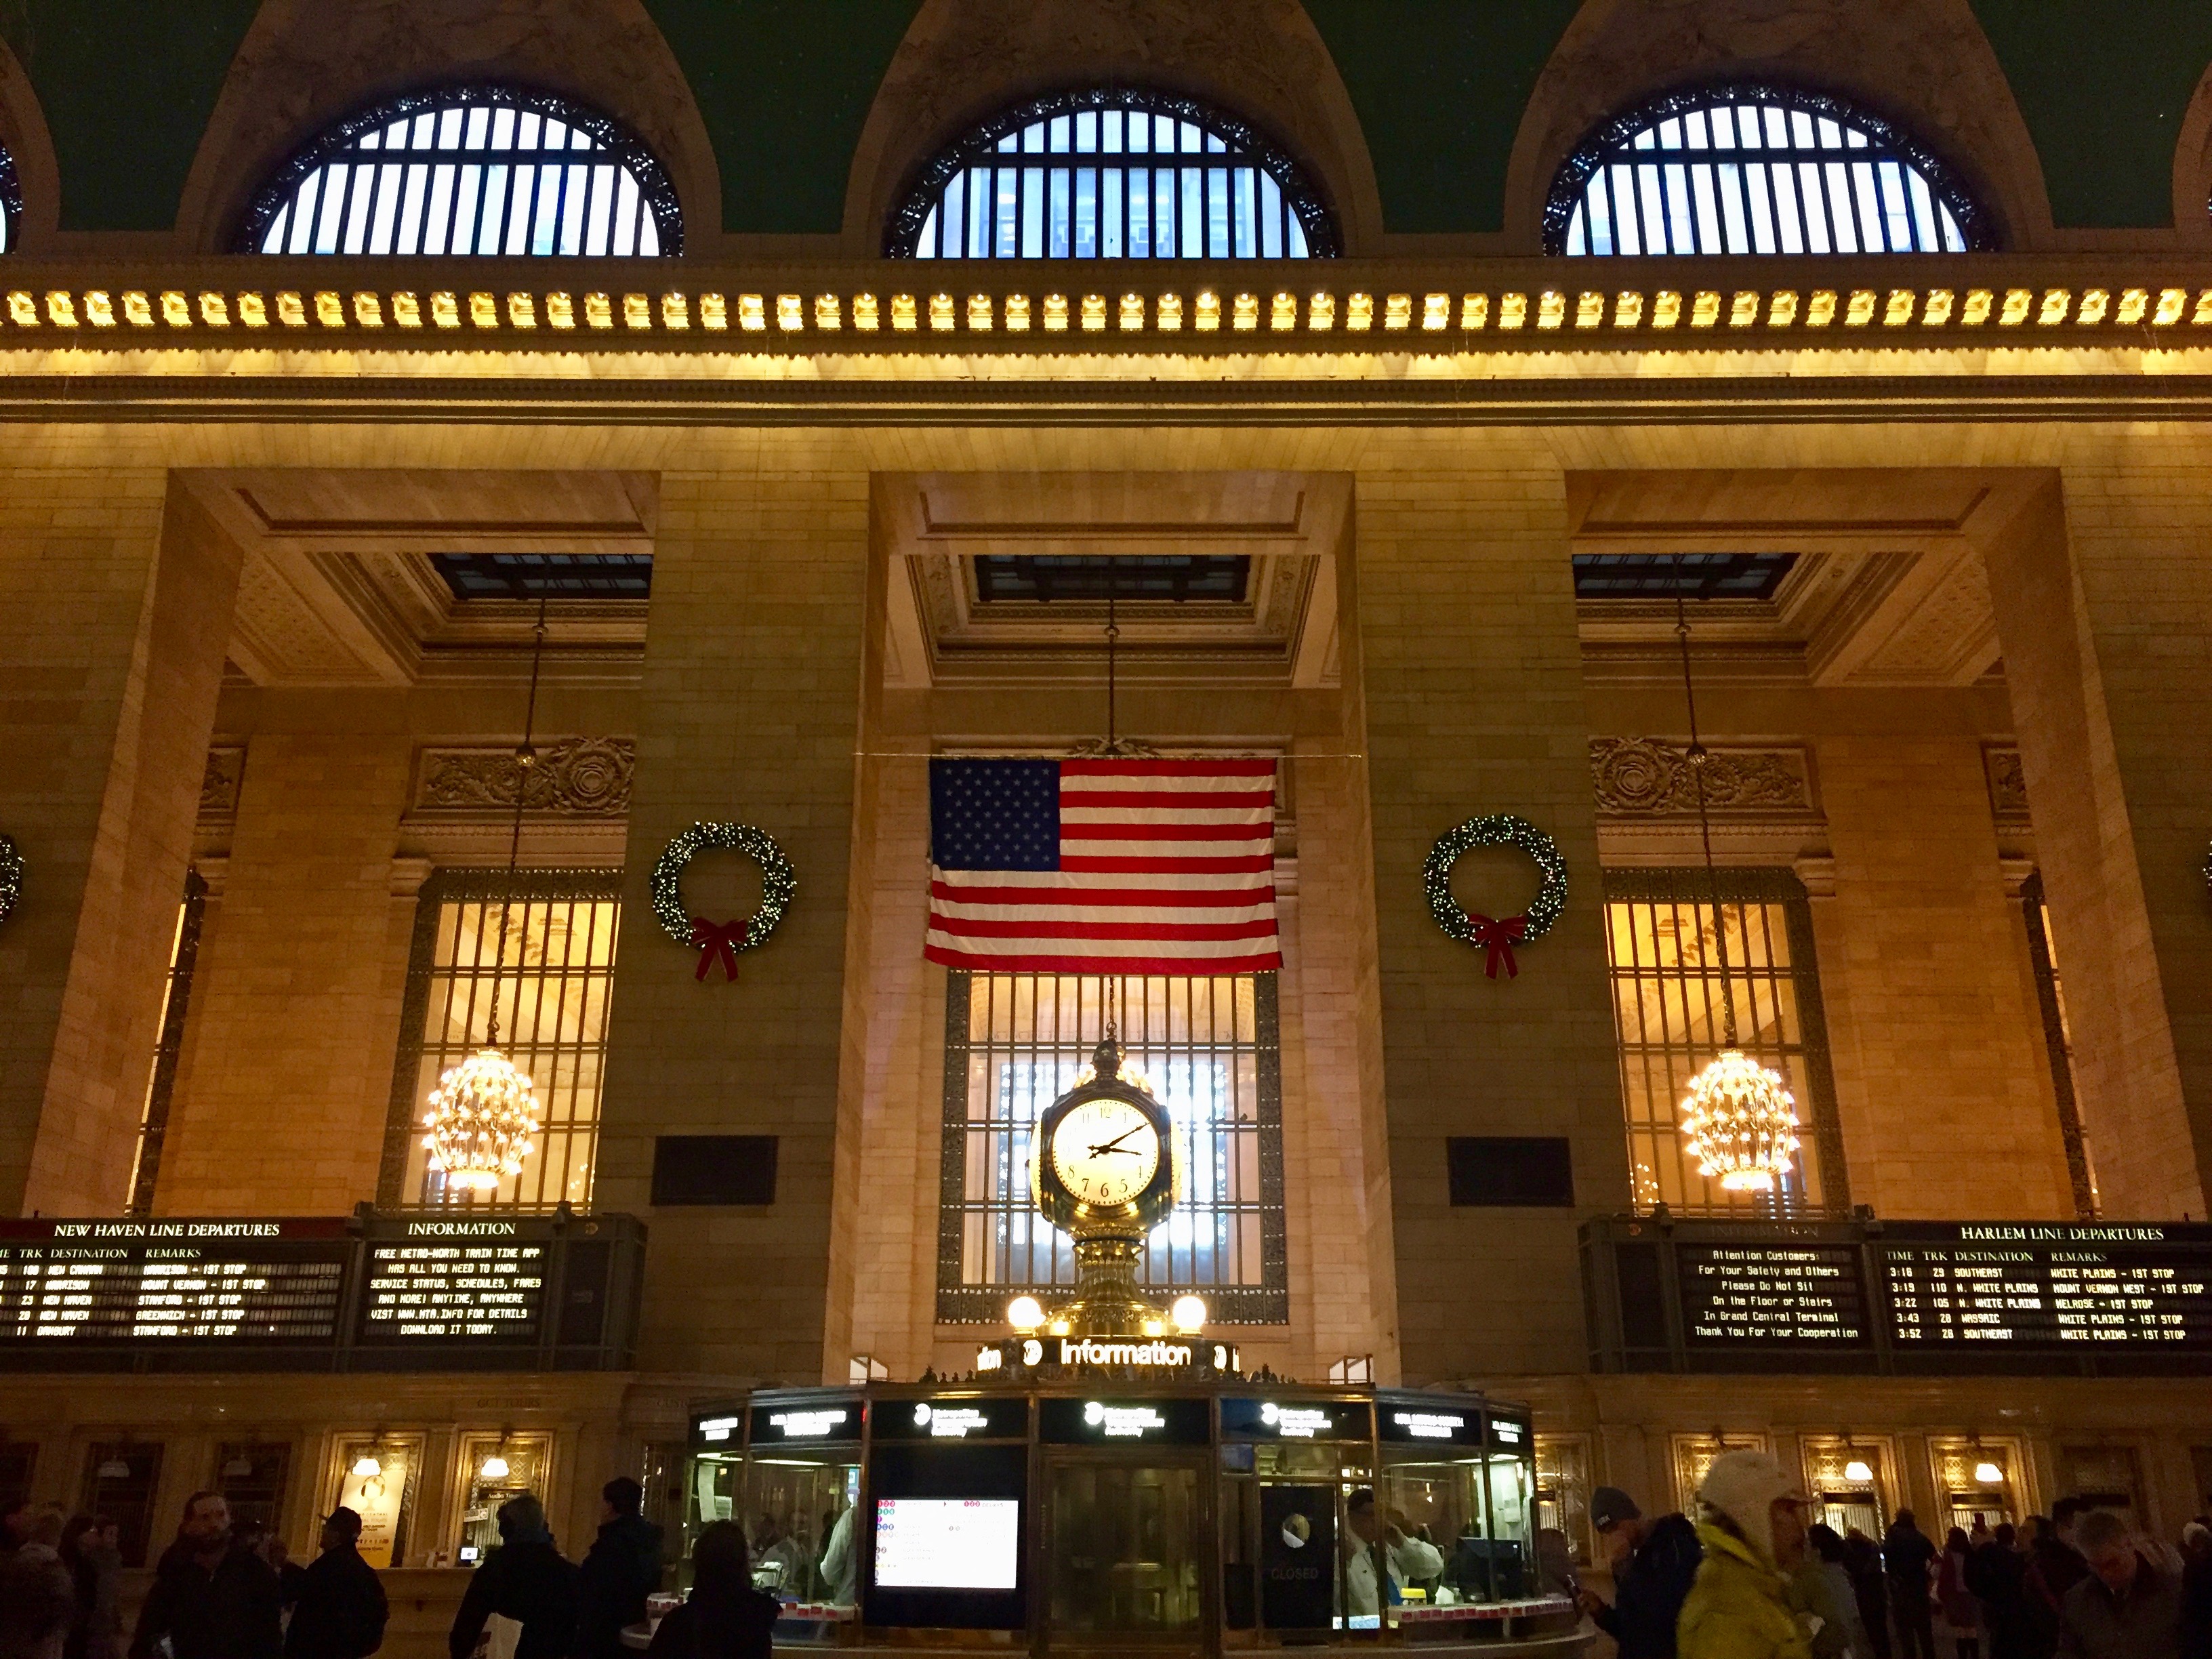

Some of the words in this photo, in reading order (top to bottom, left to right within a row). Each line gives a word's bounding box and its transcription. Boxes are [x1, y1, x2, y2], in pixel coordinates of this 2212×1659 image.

[1067, 1165, 1075, 1179] 8
[1082, 1178, 1089, 1192] 7
[1101, 1183, 1109, 1197] 6
[1119, 1179, 1128, 1193] 5
[54, 1225, 91, 1236] NEW
[94, 1225, 145, 1236] HAVEN
[150, 1225, 184, 1236] LINE
[188, 1224, 279, 1236] DEPARTURES
[409, 1223, 516, 1235] INFORMATION
[1961, 1227, 2026, 1239] HARLEM
[2030, 1228, 2066, 1240] LINE
[2070, 1229, 2163, 1240] DEPARTURES
[20, 1249, 43, 1258] TRK
[51, 1249, 127, 1258] DESTINATION
[145, 1249, 201, 1258] REMARKS
[375, 1249, 396, 1258] FREE
[401, 1248, 459, 1258] METRO-NORTH
[466, 1248, 492, 1258] TRAIN
[497, 1248, 518, 1258] TIME
[523, 1248, 539, 1258] APP
[1713, 1250, 1762, 1260] Attention
[1888, 1251, 1914, 1260] TIME
[1922, 1252, 1948, 1261] TRK
[1955, 1252, 2033, 1261] DESTINATION
[2051, 1252, 2107, 1262] REMARKS
[48, 1265, 66, 1275] NEW
[203, 1265, 220, 1274] 1ST
[224, 1265, 246, 1274] STOP
[388, 1264, 405, 1273] HAS
[409, 1264, 426, 1273] ALL
[432, 1263, 448, 1273] YOU
[452, 1263, 474, 1273] NEED
[480, 1264, 490, 1273] TO
[494, 1263, 519, 1273] KNOW.
[1699, 1265, 1715, 1274] For
[1720, 1266, 1742, 1275] Your
[1747, 1266, 1780, 1277] Safety
[1784, 1267, 1801, 1275] and
[1805, 1267, 1839, 1276] Others
[1933, 1268, 1944, 1277] 29
[1954, 1268, 2002, 1277] SOUTHEAST
[2051, 1269, 2078, 1278] WHITE
[2083, 1269, 2116, 1278] PLAINS
[2132, 1269, 2147, 1278] 1ST
[2152, 1269, 2174, 1278] STOP
[26, 1280, 37, 1290] 17
[141, 1279, 169, 1290] MOUNT
[173, 1280, 207, 1290] VERNON
[222, 1279, 239, 1290] 1ST
[243, 1279, 266, 1289] STOP
[370, 1279, 408, 1288] SERVICE
[413, 1279, 449, 1289] STATUS,
[456, 1278, 508, 1289] SCHEDULES,
[514, 1278, 541, 1288] FARES
[1722, 1281, 1755, 1290] Please
[1760, 1282, 1771, 1290] Do
[1776, 1282, 1791, 1290] Not
[1797, 1282, 1813, 1291] Sit
[1892, 1283, 1914, 1292] 3:19
[1931, 1283, 1946, 1292] 110
[1973, 1283, 2001, 1292] WHITE
[2005, 1283, 2039, 1293] PLAINS
[2053, 1284, 2080, 1293] MOUNT
[2086, 1284, 2118, 1294] VERNON
[2123, 1284, 2145, 1294] WEST
[2162, 1284, 2176, 1294] 1ST
[2182, 1284, 2204, 1293] STOP
[21, 1296, 33, 1305] 23
[43, 1295, 60, 1305] NEW
[64, 1295, 92, 1305] HAVEN
[138, 1295, 182, 1305] STAMFORD
[199, 1294, 215, 1305] 1ST
[219, 1294, 241, 1305] STOP
[378, 1294, 395, 1304] AND
[400, 1294, 426, 1304] MORE!
[432, 1294, 473, 1305] ANYTIME,
[480, 1293, 524, 1303] ANYWHERE
[1713, 1296, 1724, 1305] On
[1731, 1296, 1746, 1305] the
[1751, 1296, 1778, 1305] Floor
[1799, 1297, 1832, 1307] Stairs
[1894, 1298, 1917, 1307] 3:22
[1933, 1298, 1949, 1307] 105
[1975, 1298, 2003, 1308] WHITE
[2007, 1298, 2041, 1309] PLAINS
[2055, 1299, 2095, 1309] MELROSE
[2110, 1299, 2125, 1309] 1ST
[2131, 1299, 2153, 1309] STOP
[40, 1311, 57, 1320] NEW
[61, 1311, 89, 1320] HAVEN
[136, 1310, 185, 1320] GREENWICH
[201, 1310, 218, 1320] 1ST
[222, 1310, 245, 1319] STOP
[398, 1309, 463, 1319] WWW.MTA.INFO
[467, 1309, 485, 1318] FOR
[489, 1309, 527, 1318] DETAILS
[1704, 1311, 1715, 1320] In
[1721, 1311, 1748, 1321] Grand
[1753, 1311, 1790, 1322] Central
[1796, 1312, 1838, 1322] Terminal
[1897, 1313, 1919, 1322] 3:43
[1961, 1313, 2000, 1324] WASSAIC
[2058, 1314, 2087, 1324] WHITE
[2091, 1315, 2124, 1324] PLAINS
[2140, 1315, 2156, 1324] 1ST
[2161, 1315, 2183, 1324] STOP
[17, 1326, 26, 1336] 11
[37, 1326, 76, 1336] DANBURY
[133, 1326, 178, 1336] STAMFORD
[194, 1326, 209, 1335] 1ST
[213, 1326, 237, 1335] STOP
[401, 1324, 445, 1334] DOWNLOAD
[450, 1324, 461, 1334] IT
[466, 1324, 496, 1334] TODAY.
[1695, 1326, 1723, 1336] Thank
[1727, 1327, 1744, 1336] You
[1749, 1327, 1765, 1336] For
[1771, 1328, 1793, 1336] Your
[1798, 1328, 1858, 1338] Cooperation
[1899, 1329, 1921, 1338] 3:52
[1964, 1329, 2012, 1339] SOUTHEAST
[2061, 1330, 2089, 1339] WHITE
[2093, 1330, 2127, 1340] PLAINS
[2143, 1330, 2158, 1340] 1ST
[2164, 1330, 2186, 1339] STOP
[1061, 1338, 1191, 1366] Information
